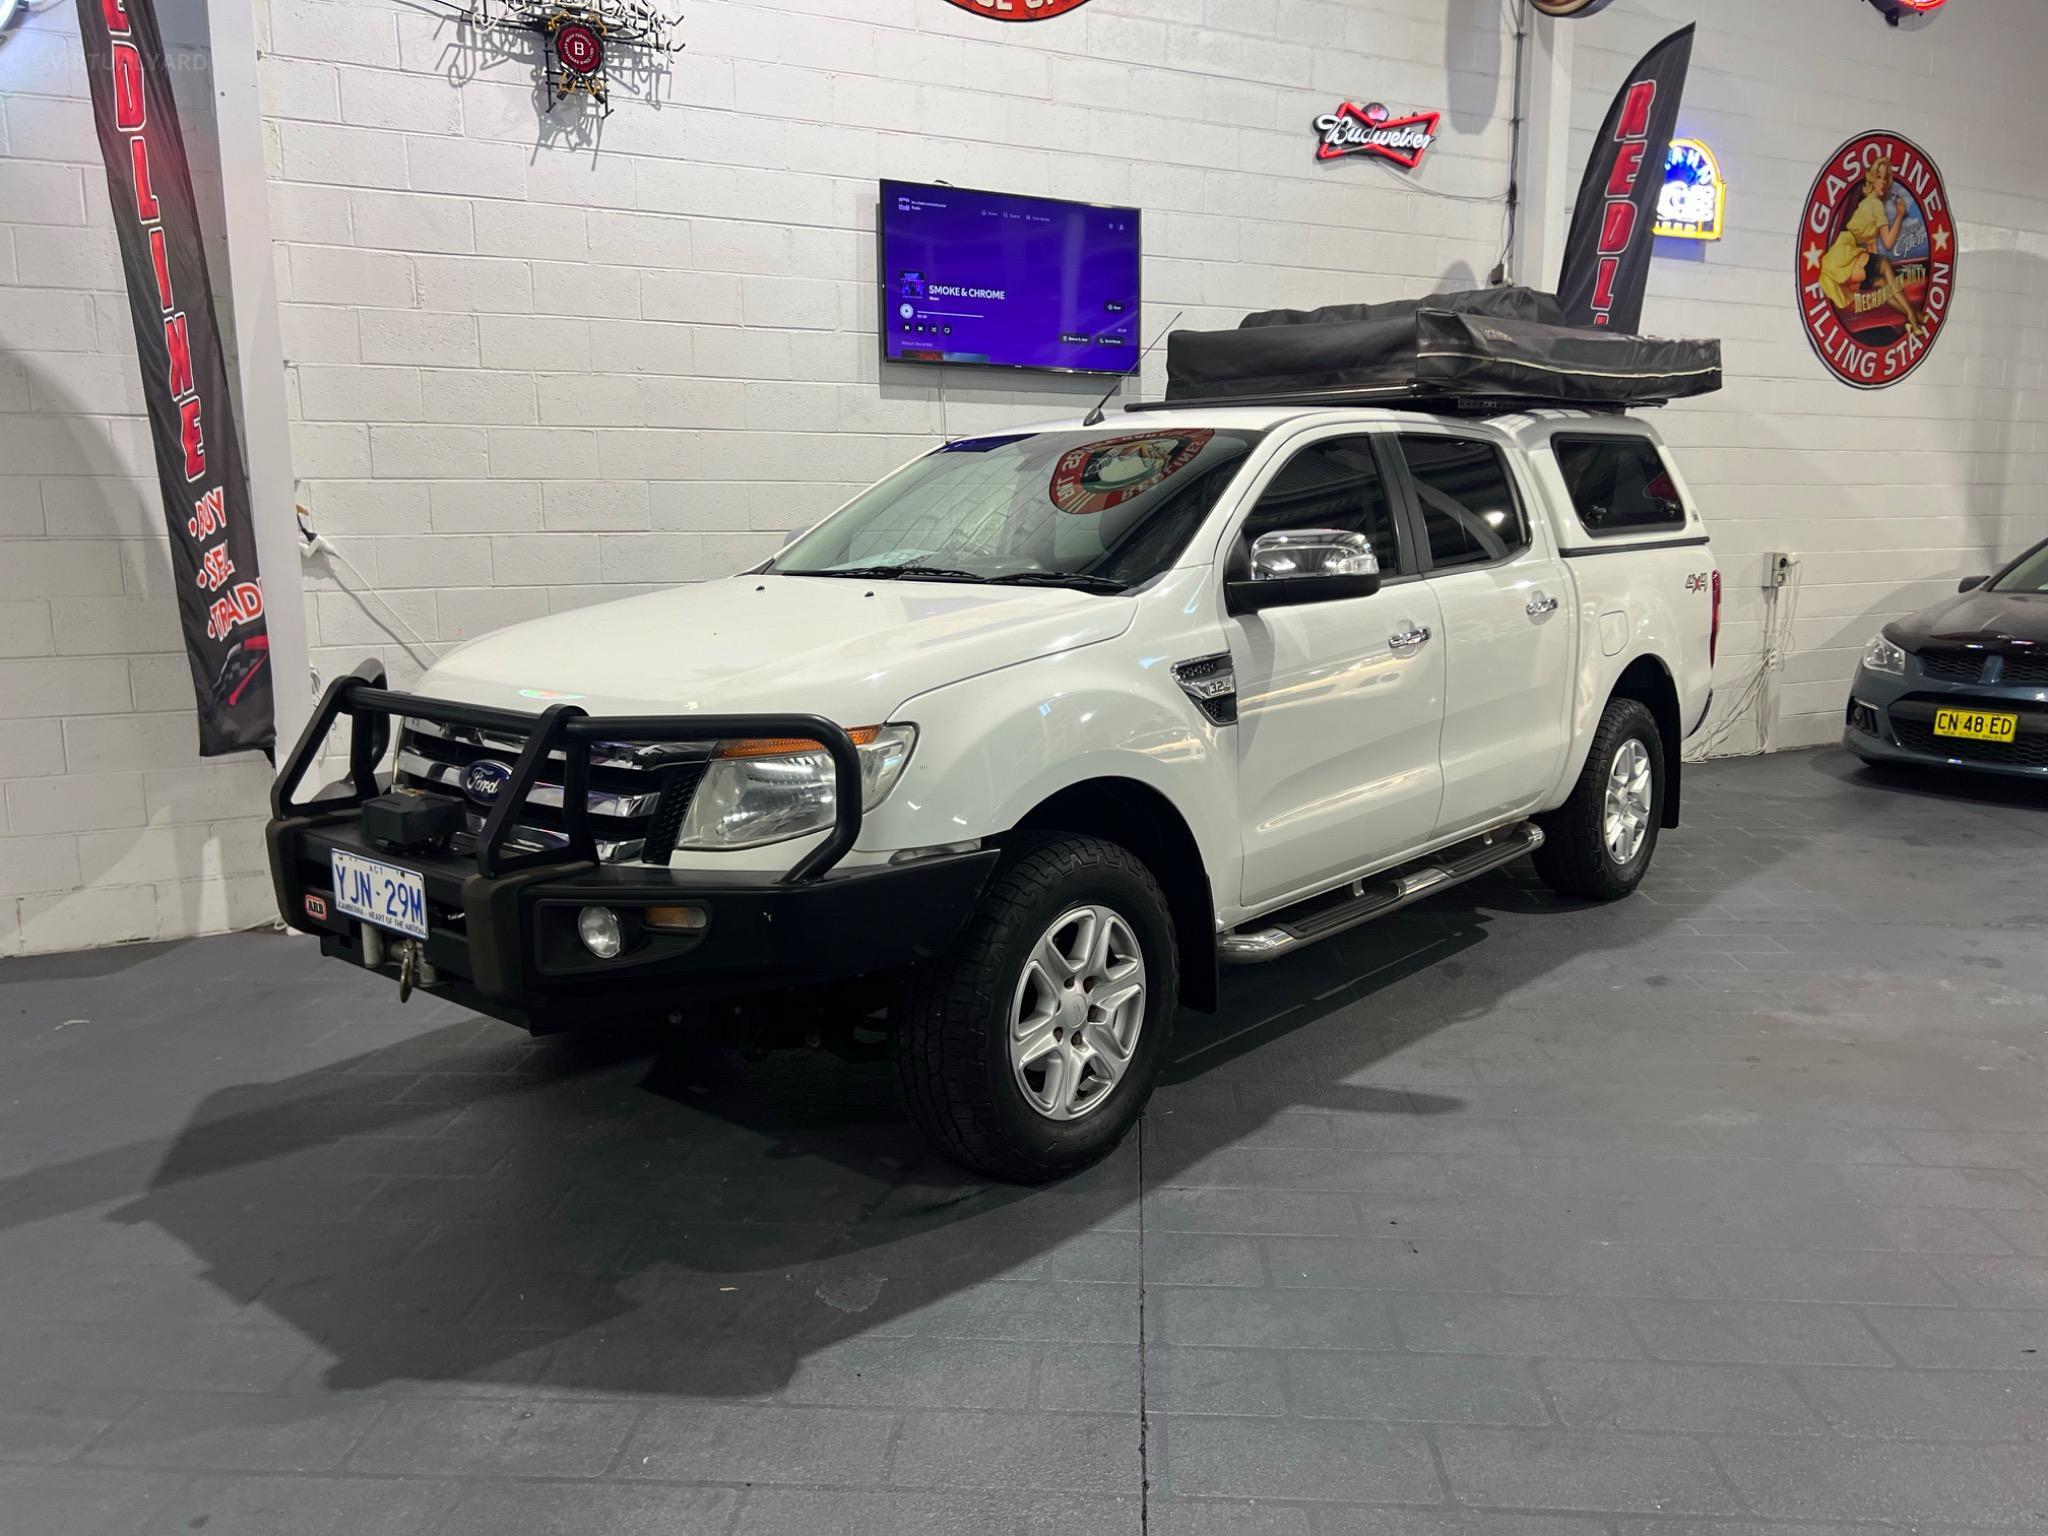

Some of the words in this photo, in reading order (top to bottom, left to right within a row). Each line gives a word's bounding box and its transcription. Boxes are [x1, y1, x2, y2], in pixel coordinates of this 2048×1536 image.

[574, 41, 585, 56] B
[1317, 114, 1431, 149] Budweiser
[1591, 80, 1656, 326] REDL
[1811, 143, 1942, 234] GASOLINE
[928, 285, 960, 297] SMOKE
[961, 288, 968, 297] &
[968, 288, 1006, 300] CHROME
[1805, 283, 1876, 377] FILLING
[195, 486, 227, 542] BUY
[209, 576, 264, 643] TRAD
[1937, 713, 1959, 731] CN
[1963, 715, 1984, 733] 48
[1989, 717, 2013, 735] ED
[466, 766, 501, 794] Ford
[369, 864, 384, 876] ACT
[308, 900, 325, 915] ARB
